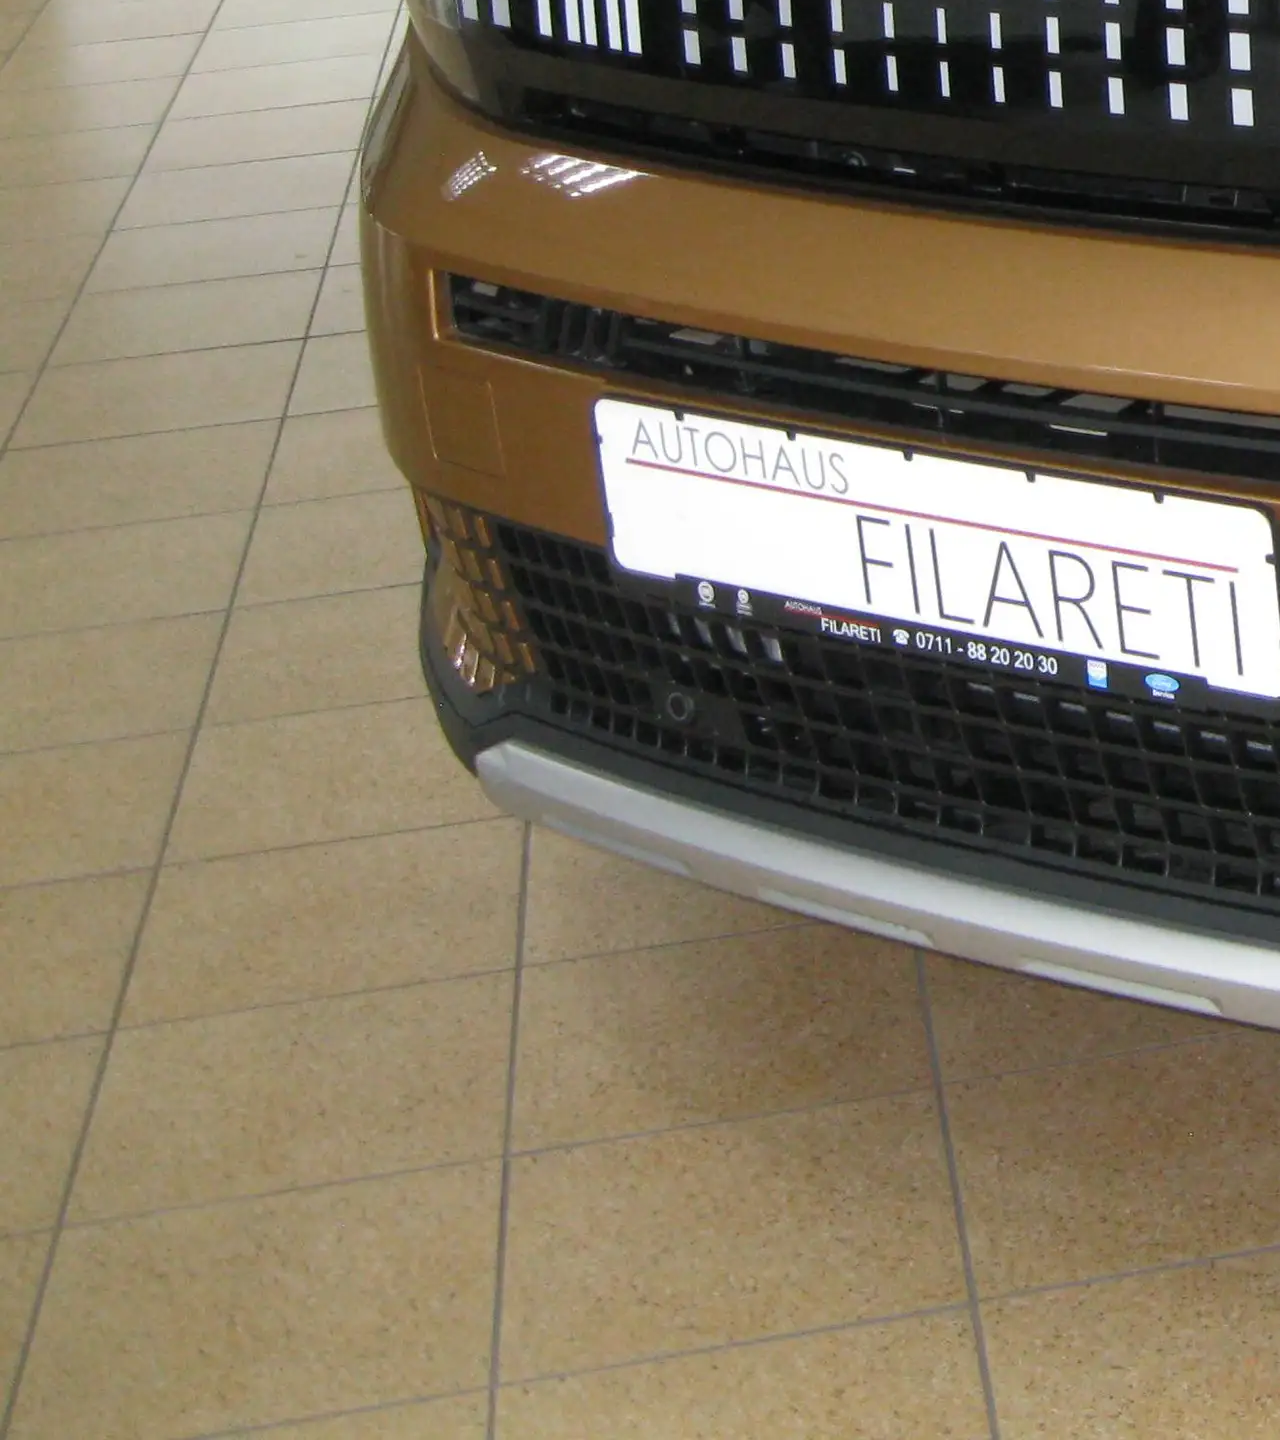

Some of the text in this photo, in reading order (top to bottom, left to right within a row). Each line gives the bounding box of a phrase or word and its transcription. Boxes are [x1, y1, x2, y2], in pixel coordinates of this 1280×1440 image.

[631, 418, 849, 495] AUTOHAUS
[784, 599, 823, 616] AUTOHAUS
[855, 514, 1245, 677] FILARETI
[820, 617, 882, 644] FILARETI
[915, 631, 952, 654] 0711
[967, 641, 987, 661] 88
[990, 646, 1010, 666] 20
[1013, 651, 1034, 670] 20
[1038, 656, 1058, 676] 30
